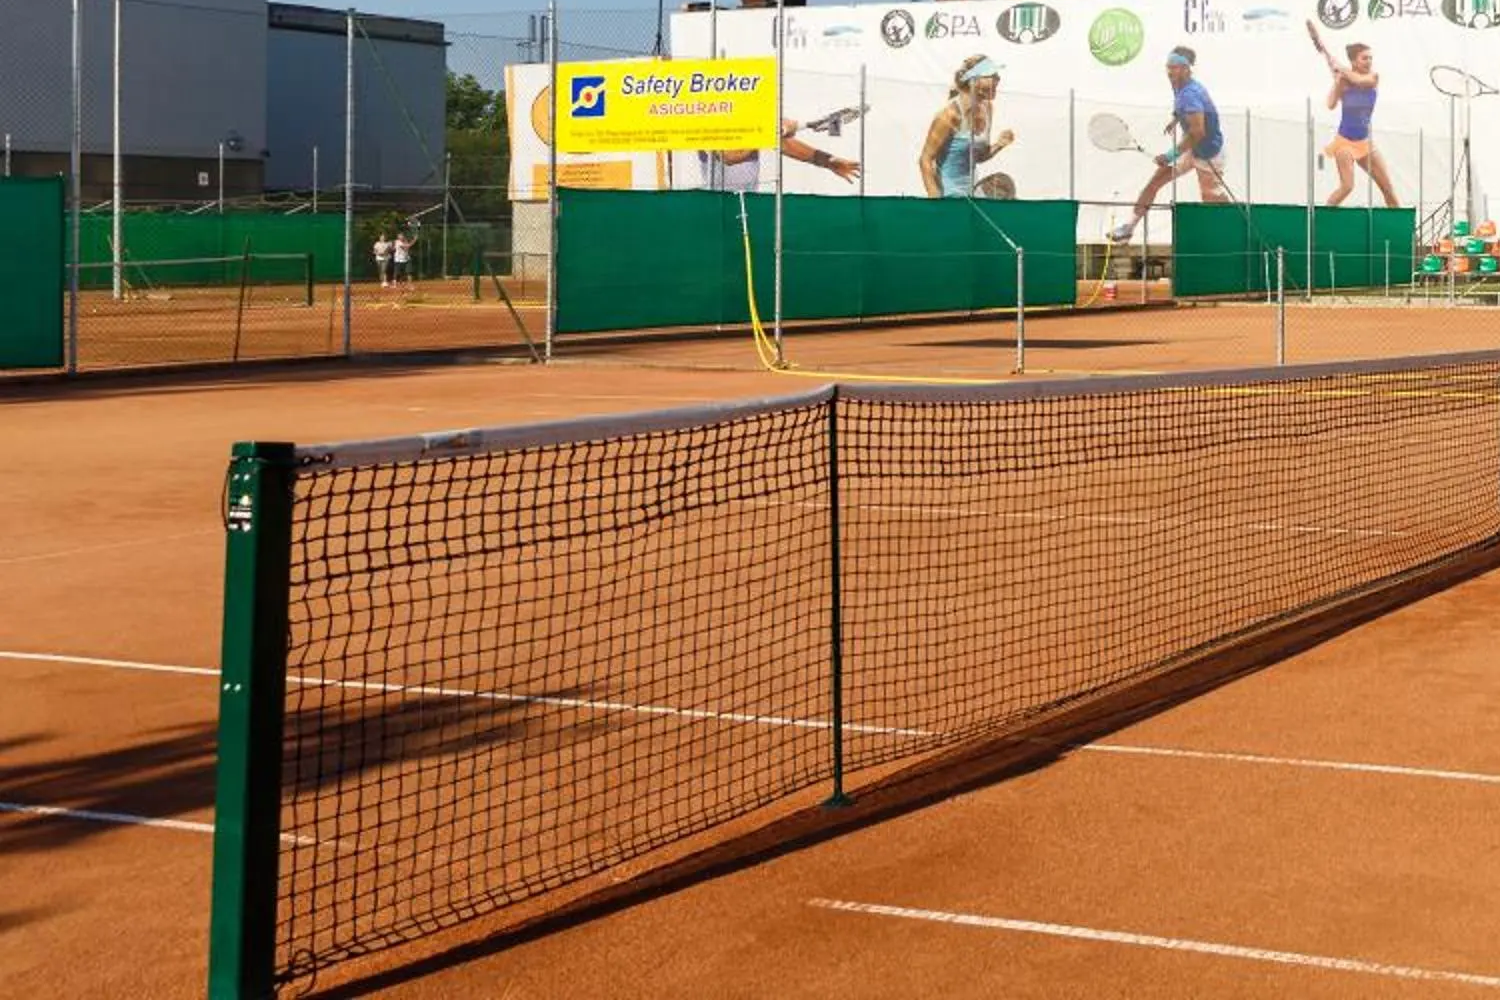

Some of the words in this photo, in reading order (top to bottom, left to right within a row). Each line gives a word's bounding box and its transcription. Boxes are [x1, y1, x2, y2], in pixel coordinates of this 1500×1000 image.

[935, 11, 982, 39] SPA
[621, 75, 684, 99] Safety
[690, 73, 761, 93] Broker
[648, 101, 733, 116] ASIGURARI
